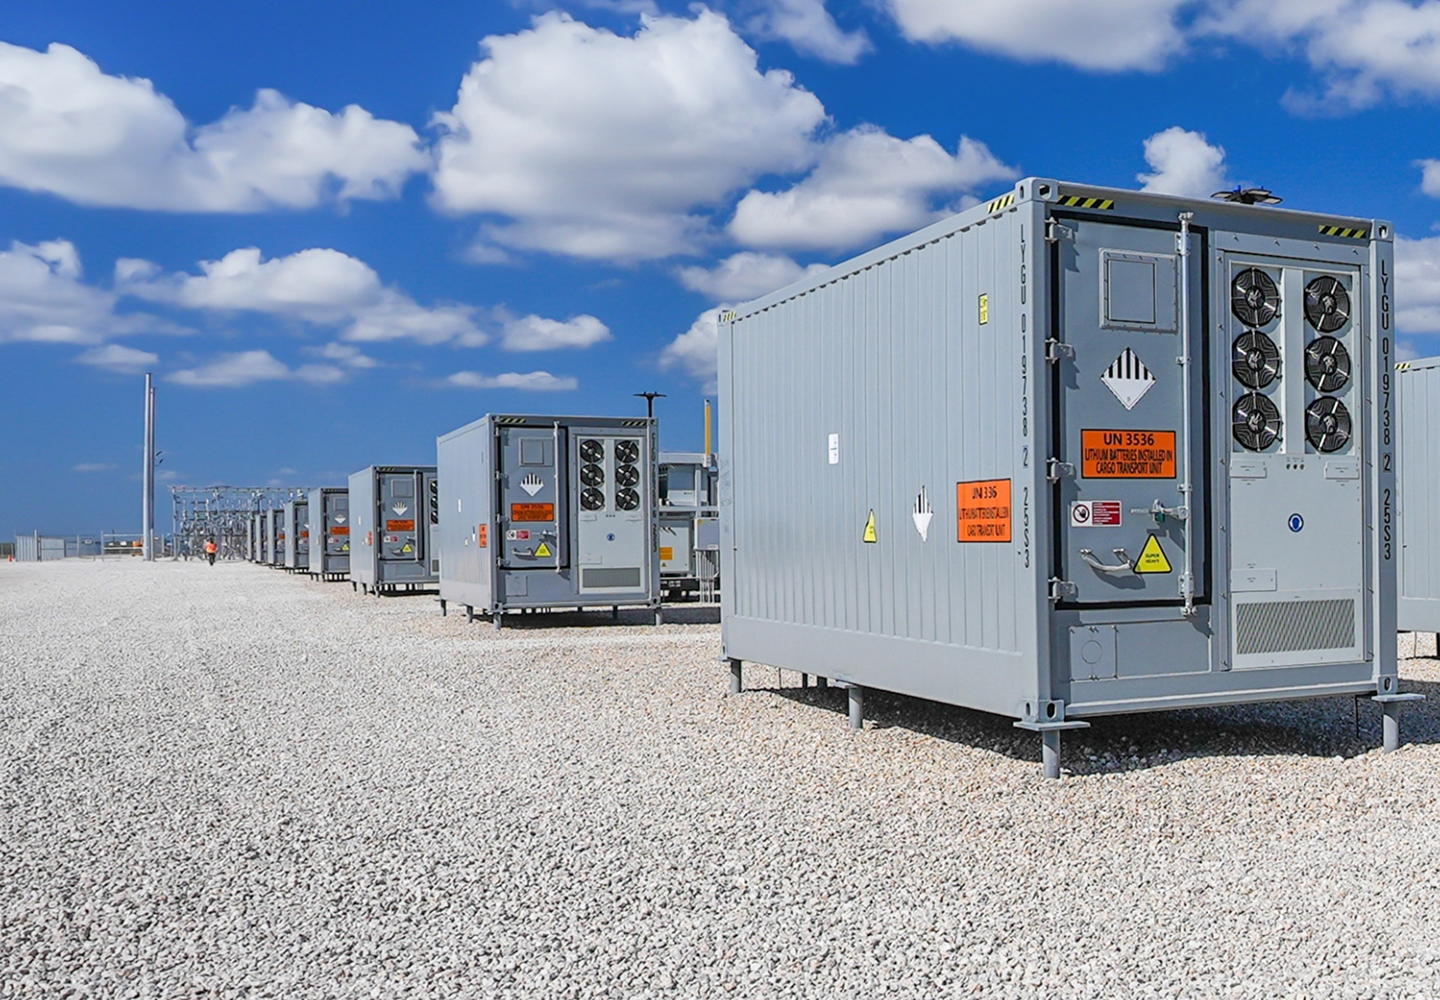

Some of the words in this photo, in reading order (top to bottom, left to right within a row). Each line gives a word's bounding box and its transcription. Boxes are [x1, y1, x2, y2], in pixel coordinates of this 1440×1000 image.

[1381, 259, 1389, 330] LYGU
[1382, 337, 1390, 445] 019738
[1103, 433, 1122, 446] UN
[1126, 433, 1155, 446] 3536
[1023, 446, 1029, 467] 2
[1085, 448, 1109, 461] LITHIUM
[1110, 448, 1137, 462] BATTERIES
[1138, 449, 1165, 462] INSTALLED
[1166, 449, 1173, 462] IN
[1384, 454, 1391, 471] 2
[1096, 462, 1116, 474] CARGO
[1117, 462, 1148, 474] TRANSPORT
[1149, 463, 1163, 475] UNIT
